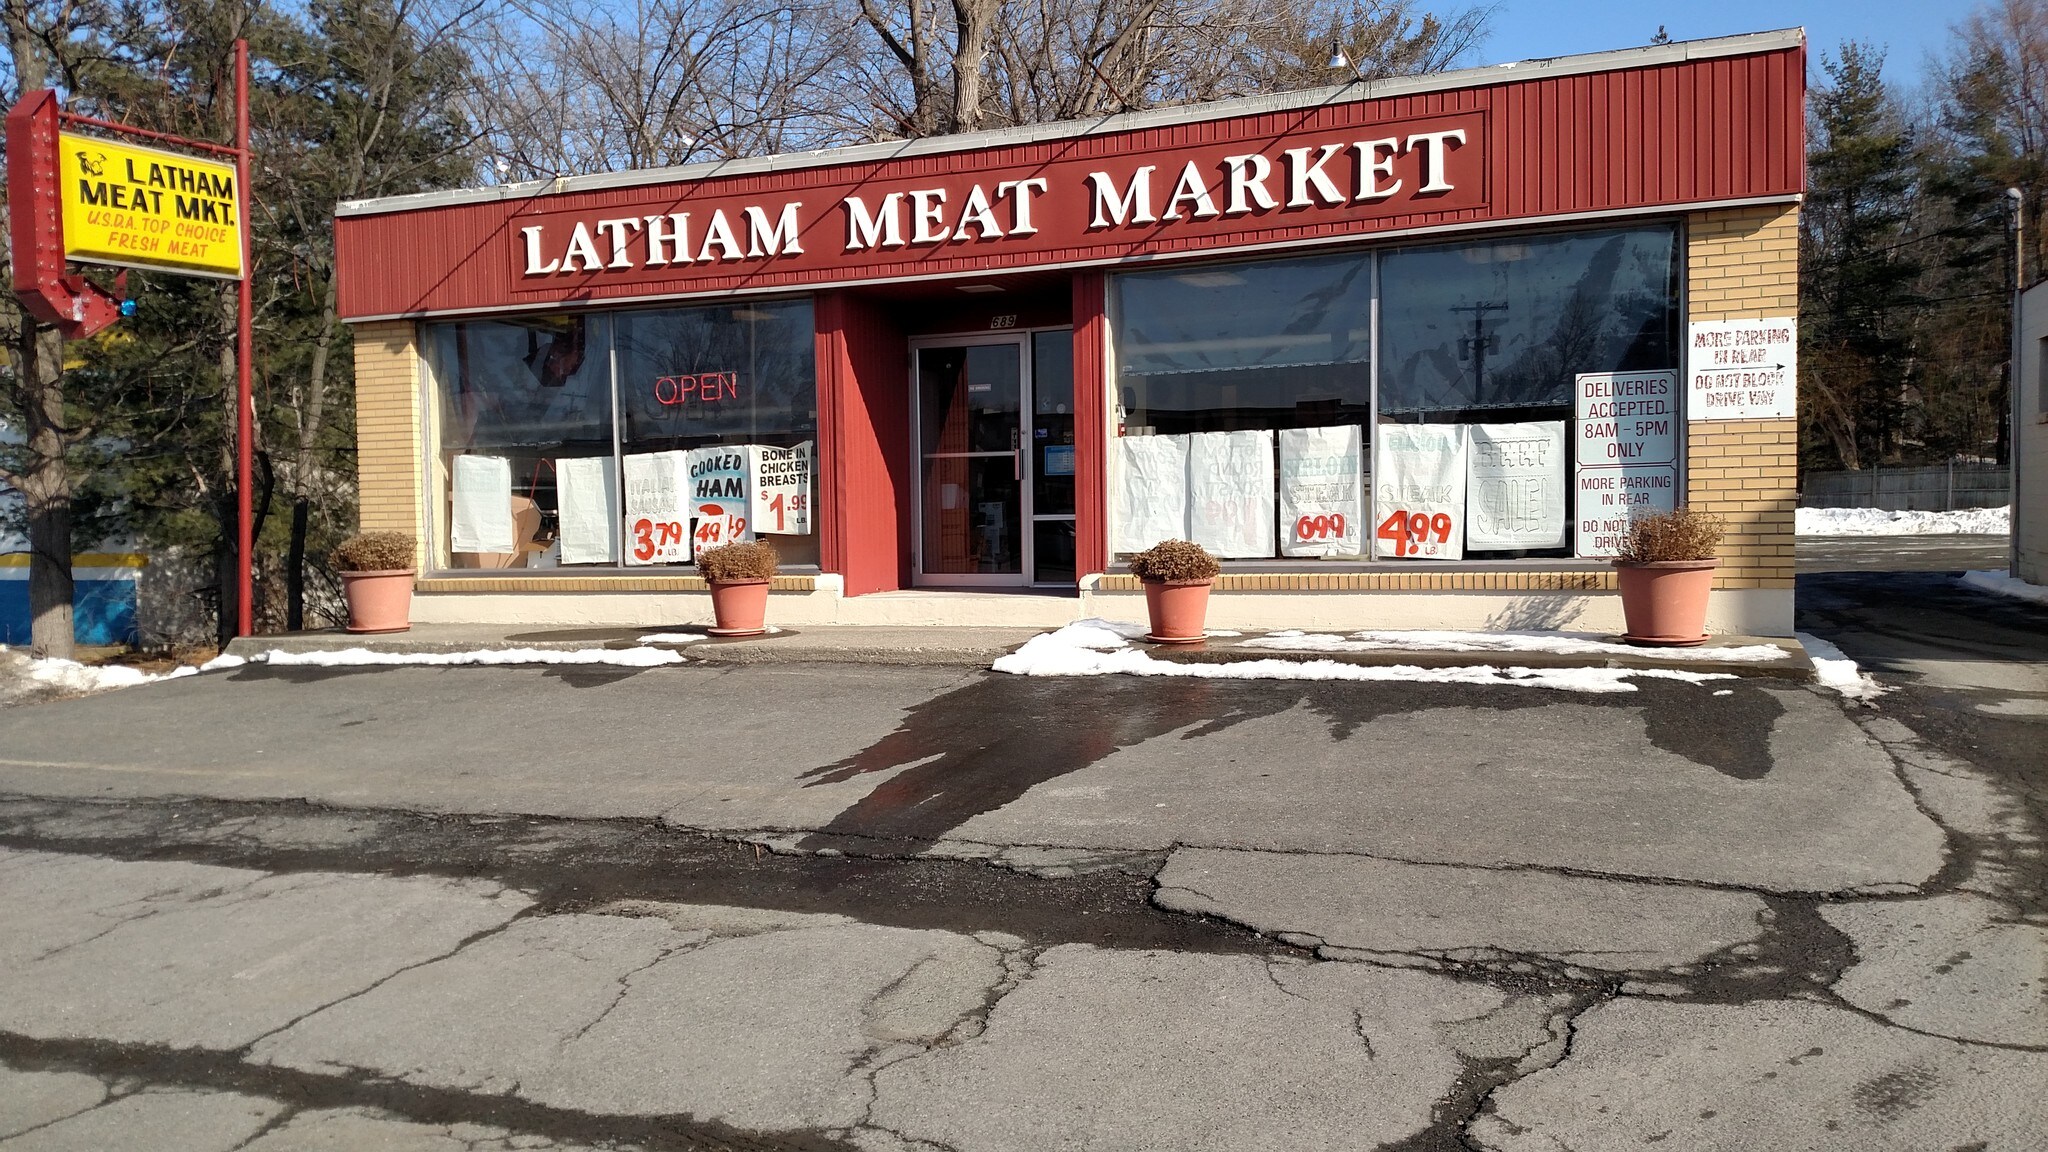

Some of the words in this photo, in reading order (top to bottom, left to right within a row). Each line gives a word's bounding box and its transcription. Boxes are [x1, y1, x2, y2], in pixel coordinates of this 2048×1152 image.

[125, 158, 234, 201] LATHAM
[79, 179, 164, 215] MEAT
[175, 194, 235, 227] MKT.
[521, 202, 804, 275] LATHAM
[844, 177, 1048, 250] MEAT
[1089, 128, 1467, 229] MARKET
[87, 210, 137, 231] U.S.D.A.
[142, 218, 170, 234] TOP
[175, 222, 227, 243] CHOICE
[107, 231, 159, 252] FRESH
[166, 240, 209, 258] MEAT
[992, 315, 1016, 328] 689
[1694, 331, 1732, 348] MORE
[1735, 328, 1790, 346] PARKING
[1714, 349, 1728, 365] IN
[1732, 348, 1767, 364] REAR
[656, 372, 737, 404] OPEN
[1585, 379, 1668, 398] DELIVERIES
[1695, 374, 1713, 390] DO
[1715, 373, 1741, 388] NOT
[1706, 391, 1745, 407] DRIVE
[1749, 389, 1776, 406] WAY
[1584, 422, 1619, 438] 8AM
[1636, 421, 1668, 436] 5PM
[761, 449, 793, 462] BONE
[796, 447, 806, 459] IN
[1607, 442, 1644, 459] ONLY
[691, 454, 742, 478] COOKED
[760, 460, 809, 474] CHICKEN
[697, 478, 743, 498] HAM
[759, 472, 809, 487] BREASTS
[1581, 476, 1615, 490] MORE
[1620, 475, 1671, 489] PARKING
[1290, 482, 1355, 504] STEAK
[1378, 483, 1453, 503] STEAK
[1602, 493, 1614, 506] IN
[1618, 491, 1650, 506] REAR
[1477, 478, 1549, 535] SALE!
[1583, 520, 1598, 533] DO
[1603, 519, 1627, 533] NOT
